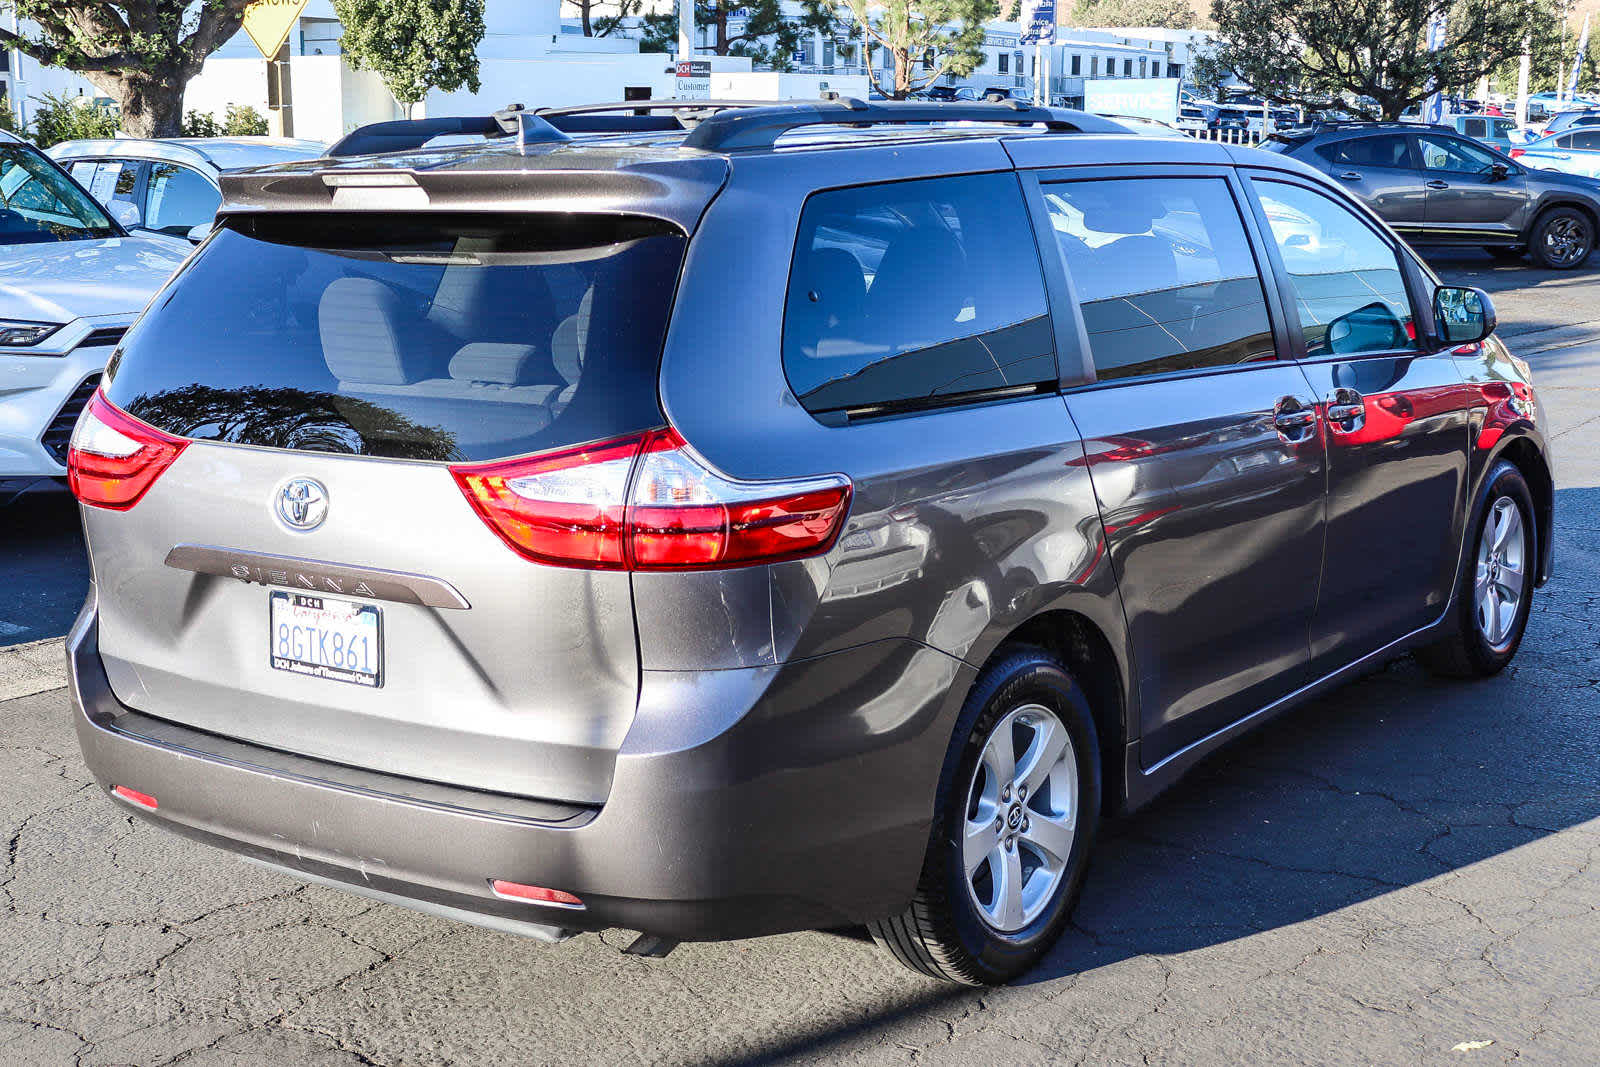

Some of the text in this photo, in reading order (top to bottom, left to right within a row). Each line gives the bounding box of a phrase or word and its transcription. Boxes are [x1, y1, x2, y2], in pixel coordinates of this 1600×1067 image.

[678, 79, 709, 91] Customer
[1089, 92, 1172, 111] SERVICE
[231, 563, 376, 597] SIENNA
[300, 597, 321, 608] DCH
[279, 623, 372, 674] 8GTK861
